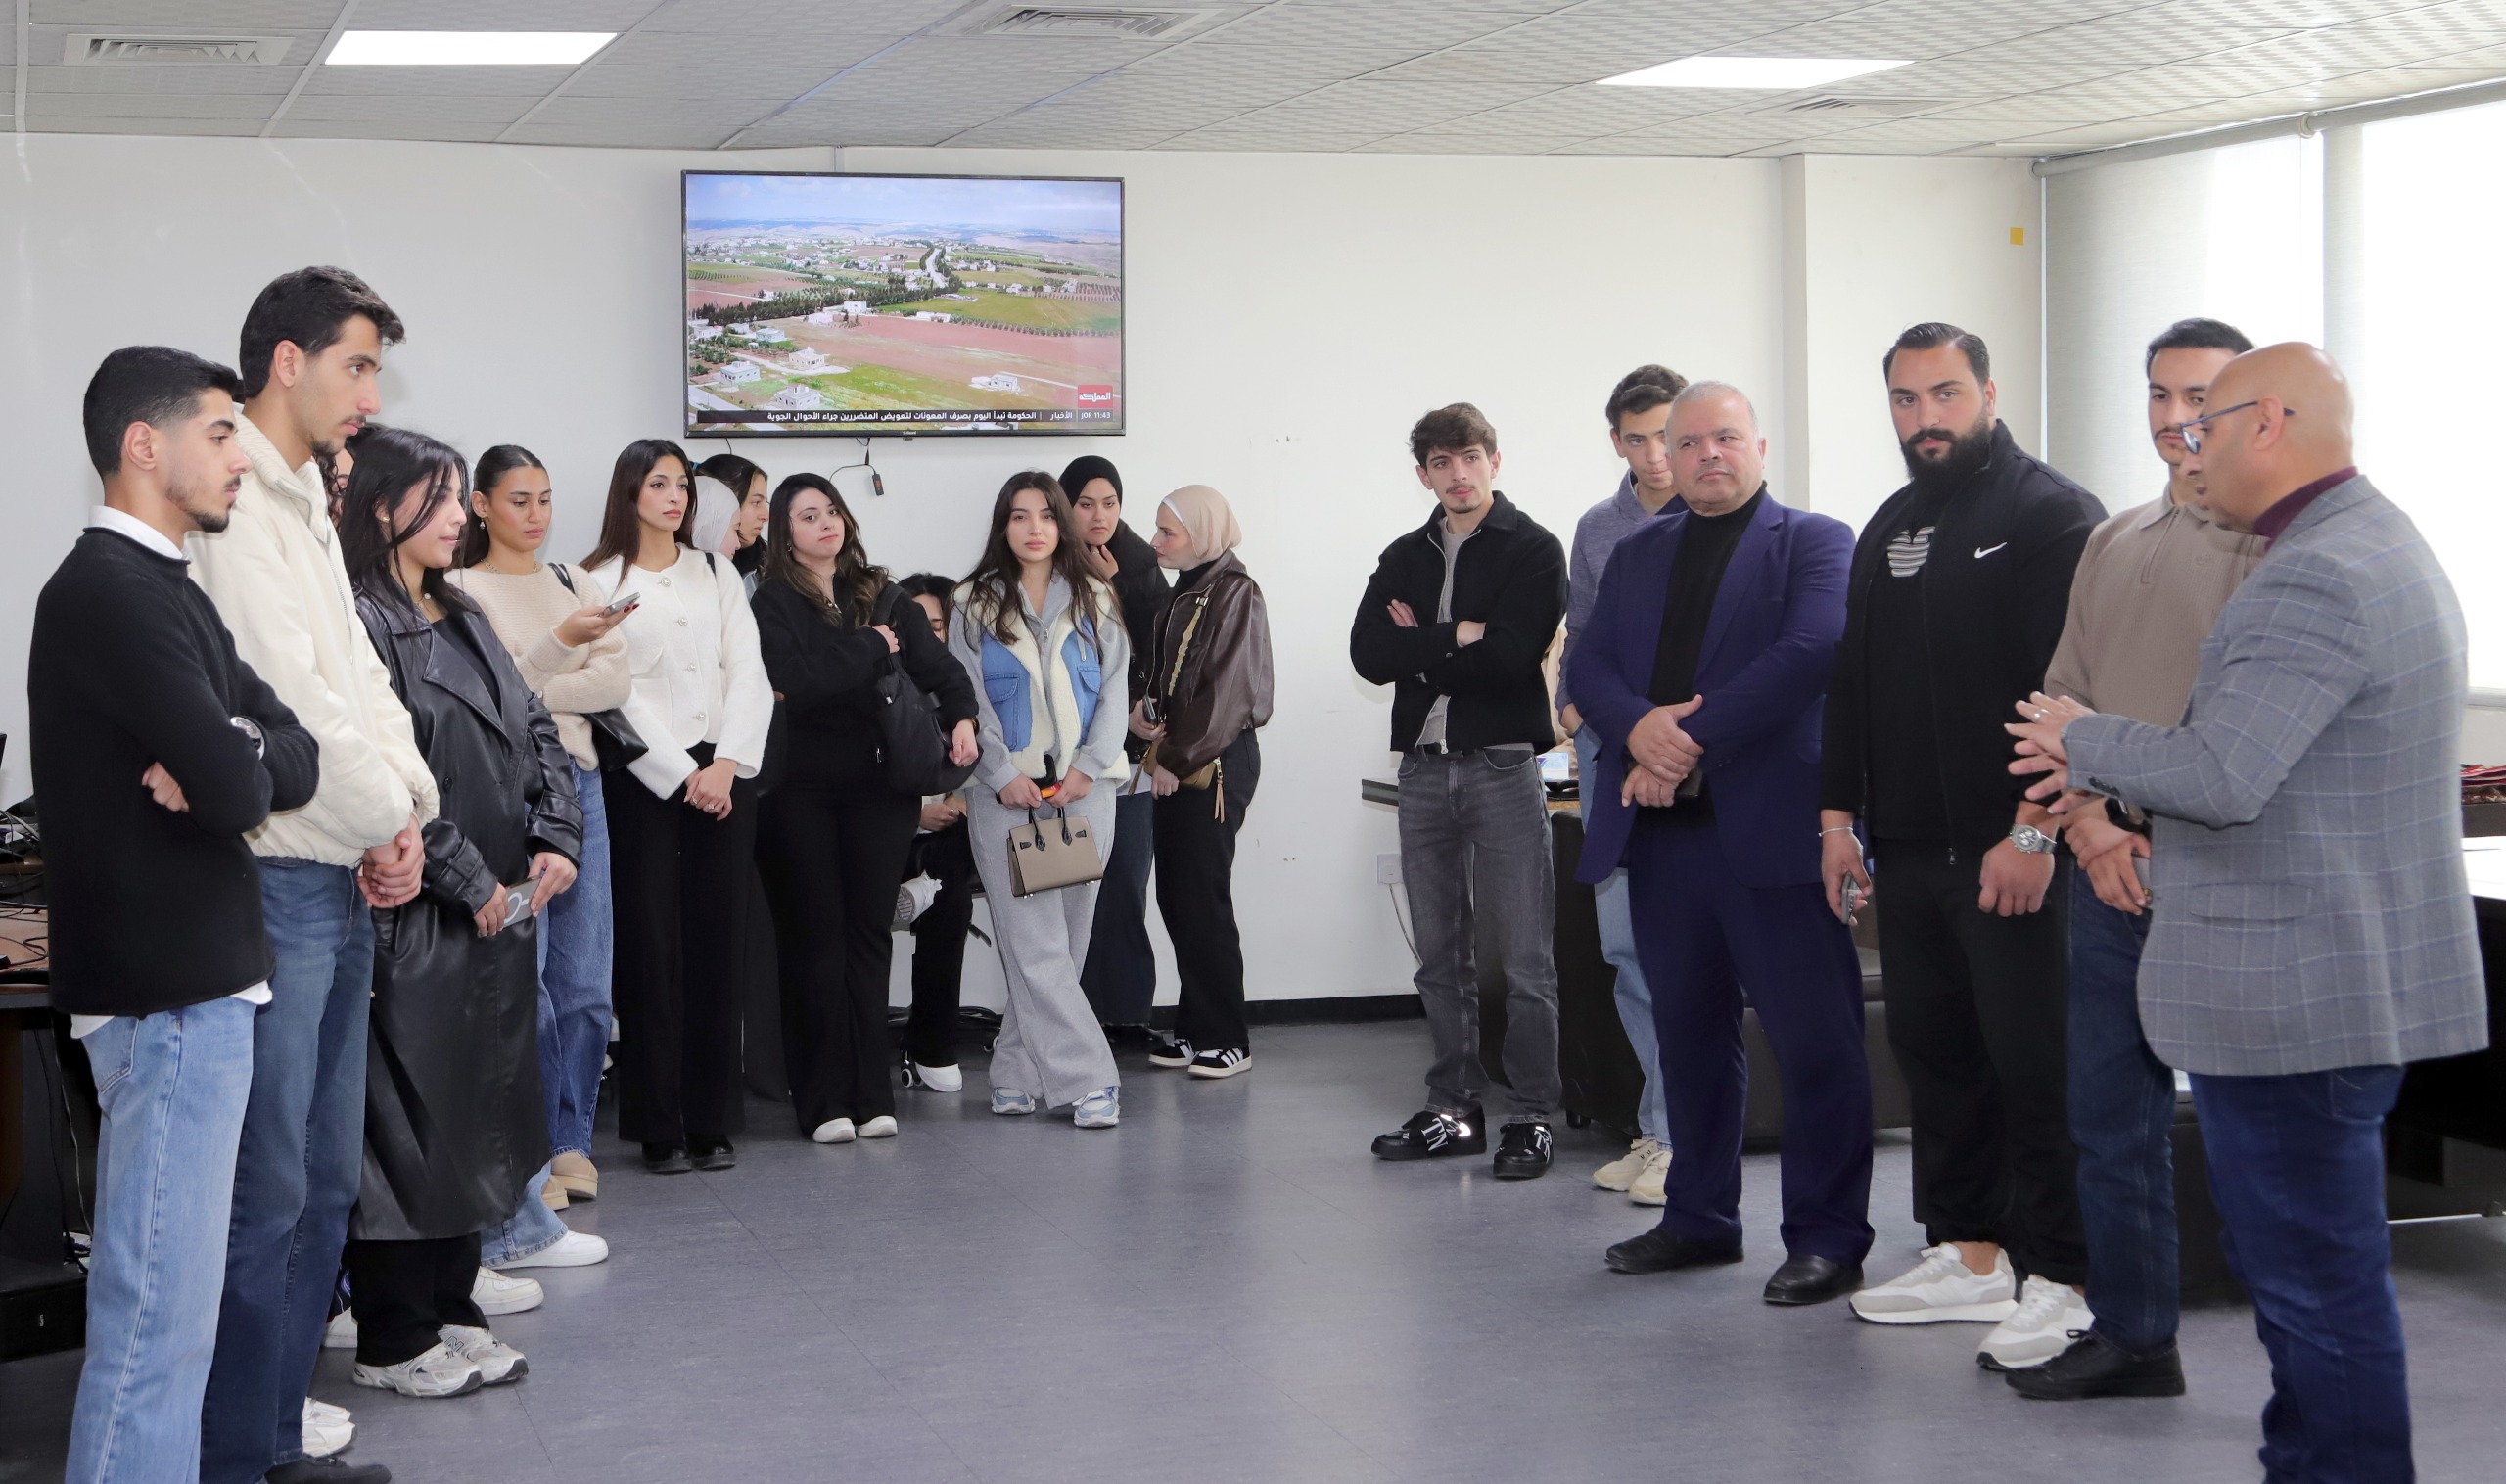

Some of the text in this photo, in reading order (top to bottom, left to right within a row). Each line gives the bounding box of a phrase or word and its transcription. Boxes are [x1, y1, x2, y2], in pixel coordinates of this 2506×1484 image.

[1079, 392, 1111, 403] المملكة
[767, 412, 791, 421] الجوية
[793, 412, 820, 421] الأحوال
[822, 412, 838, 421] جراء
[840, 412, 879, 421] المتضررين
[880, 412, 911, 421] لتعويض
[913, 412, 947, 421] المعونات
[949, 412, 972, 421] بصرف
[973, 412, 992, 422] اليوم
[1007, 412, 1037, 421] الحكومة
[1050, 411, 1073, 421] الأخبار
